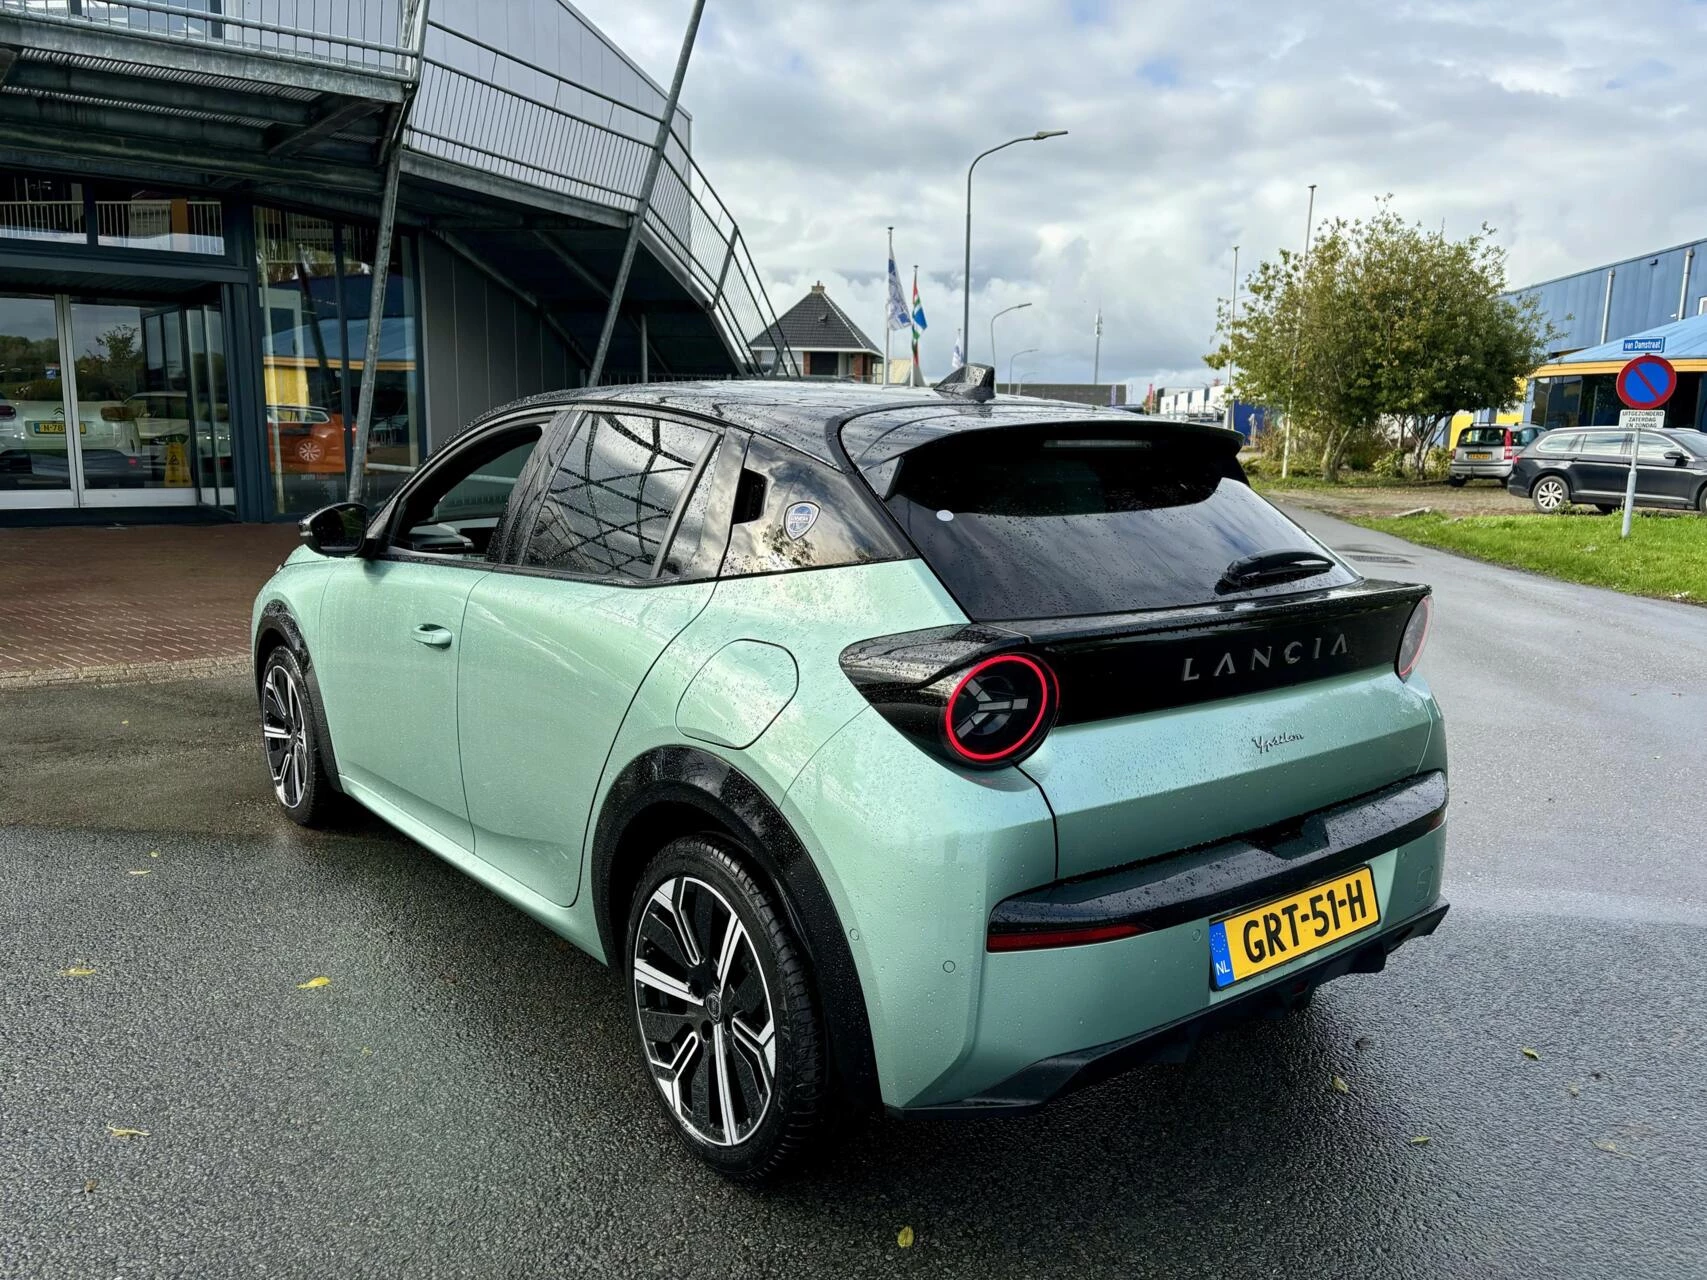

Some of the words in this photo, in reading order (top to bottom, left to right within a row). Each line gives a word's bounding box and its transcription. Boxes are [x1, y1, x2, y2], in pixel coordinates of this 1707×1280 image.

[1634, 340, 1661, 349] Damstraat
[1181, 633, 1348, 682] LANCIA
[1251, 731, 1305, 754] Ypsilon
[1242, 879, 1368, 964] GRT-51-H
[1215, 959, 1231, 976] NL
